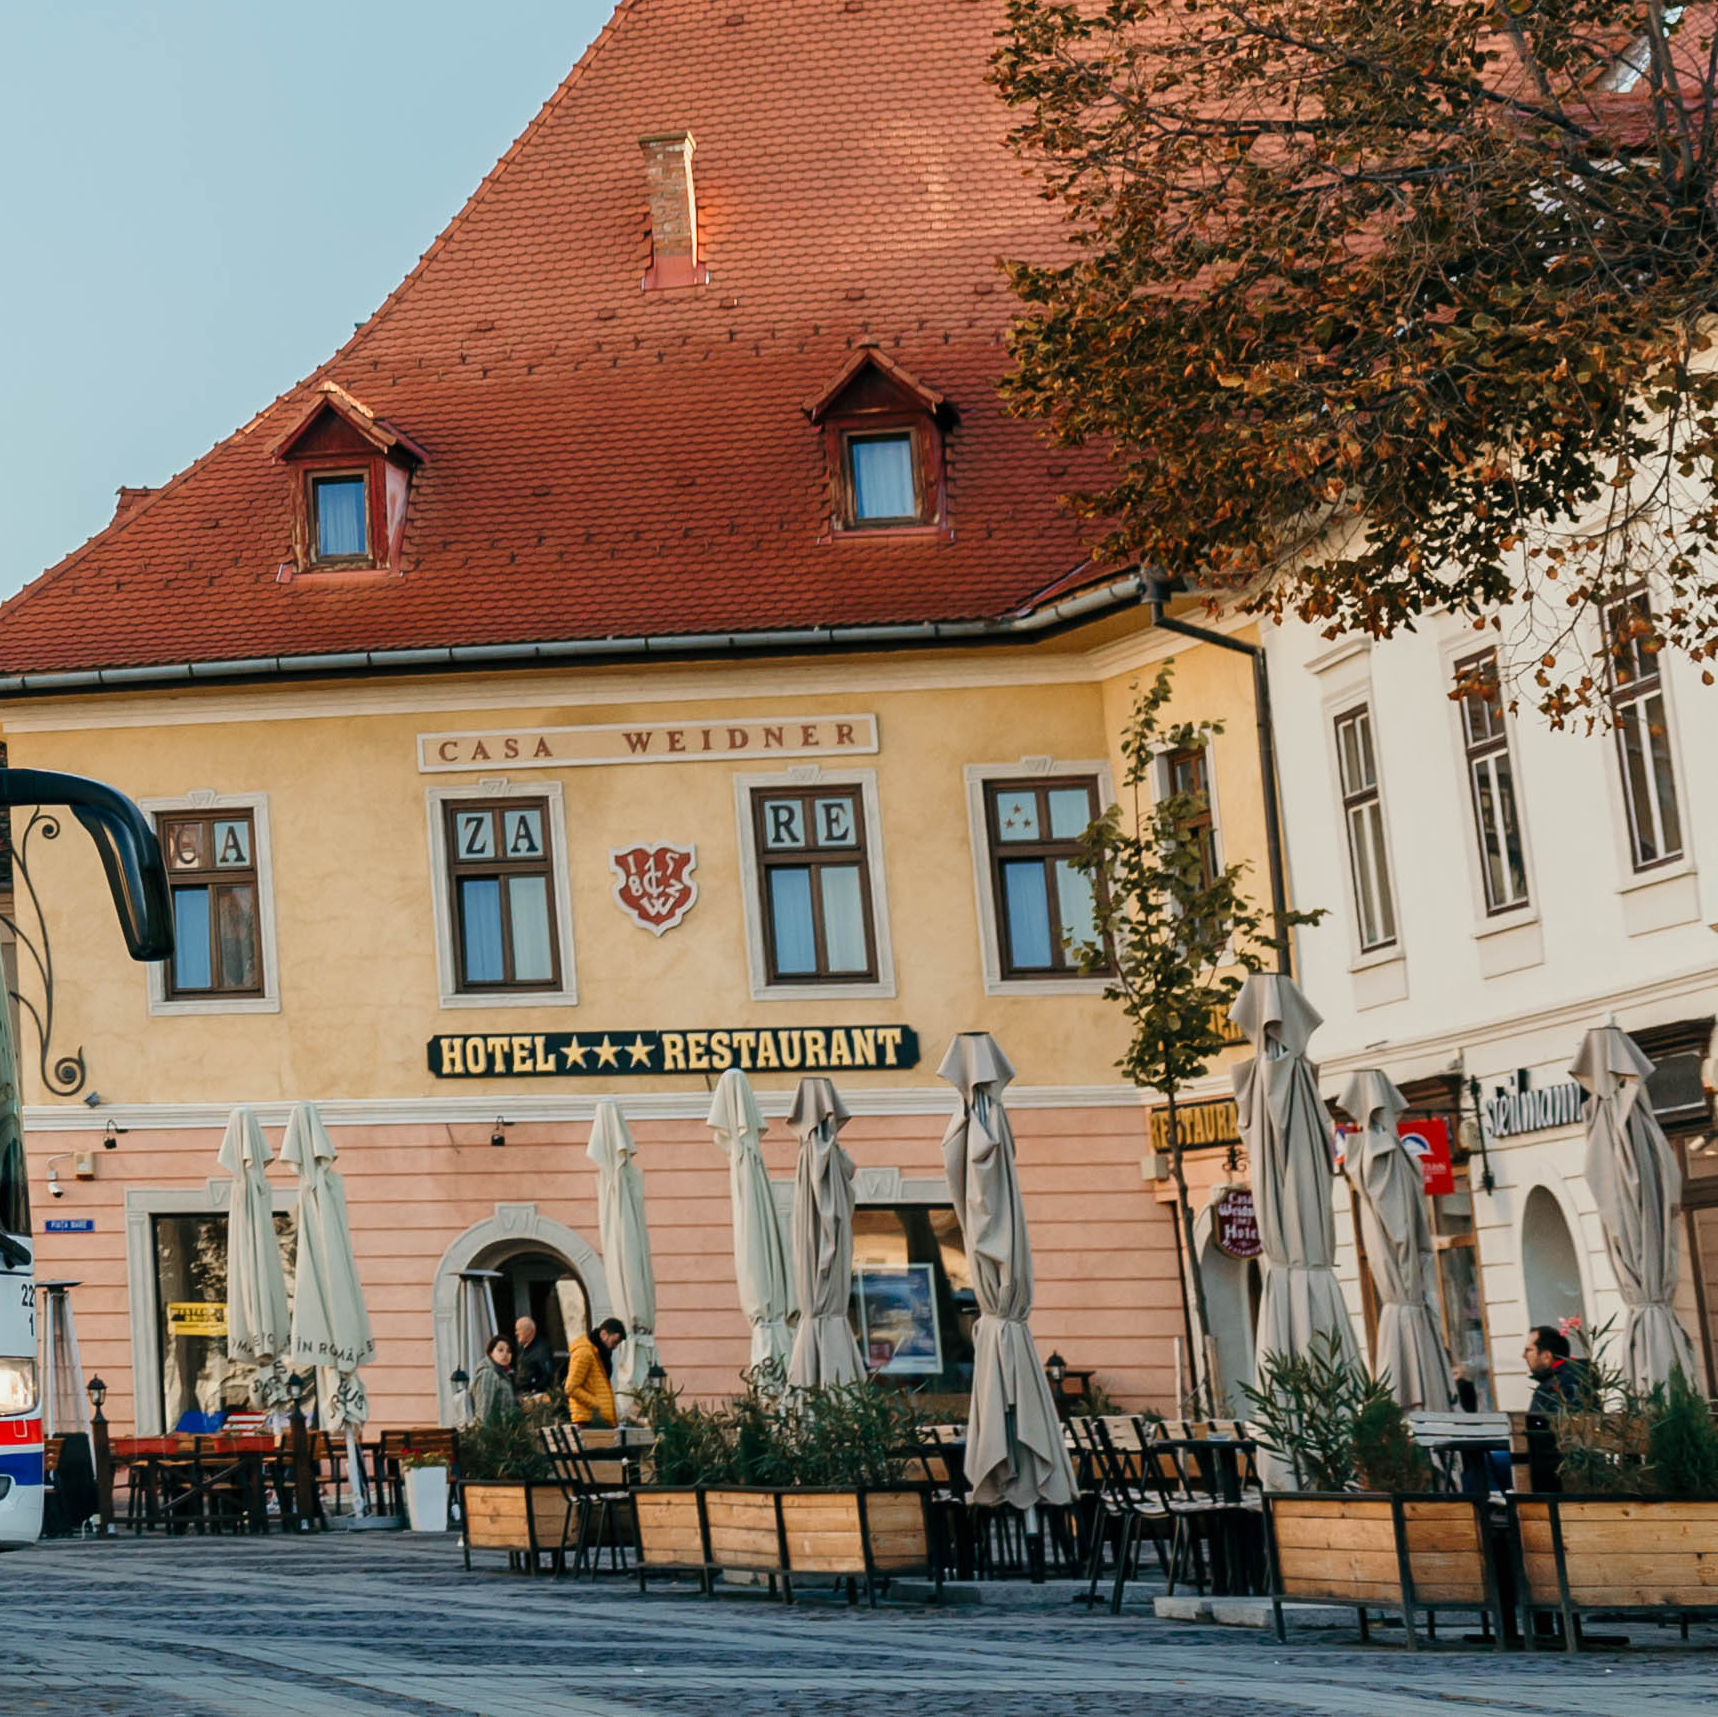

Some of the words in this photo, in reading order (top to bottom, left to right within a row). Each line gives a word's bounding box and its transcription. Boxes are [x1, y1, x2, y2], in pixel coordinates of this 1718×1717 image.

[437, 736, 554, 763] CASA
[621, 723, 857, 755] WEIDNER
[439, 1034, 557, 1075] HOTEL
[661, 1027, 903, 1072] RESTAURANT
